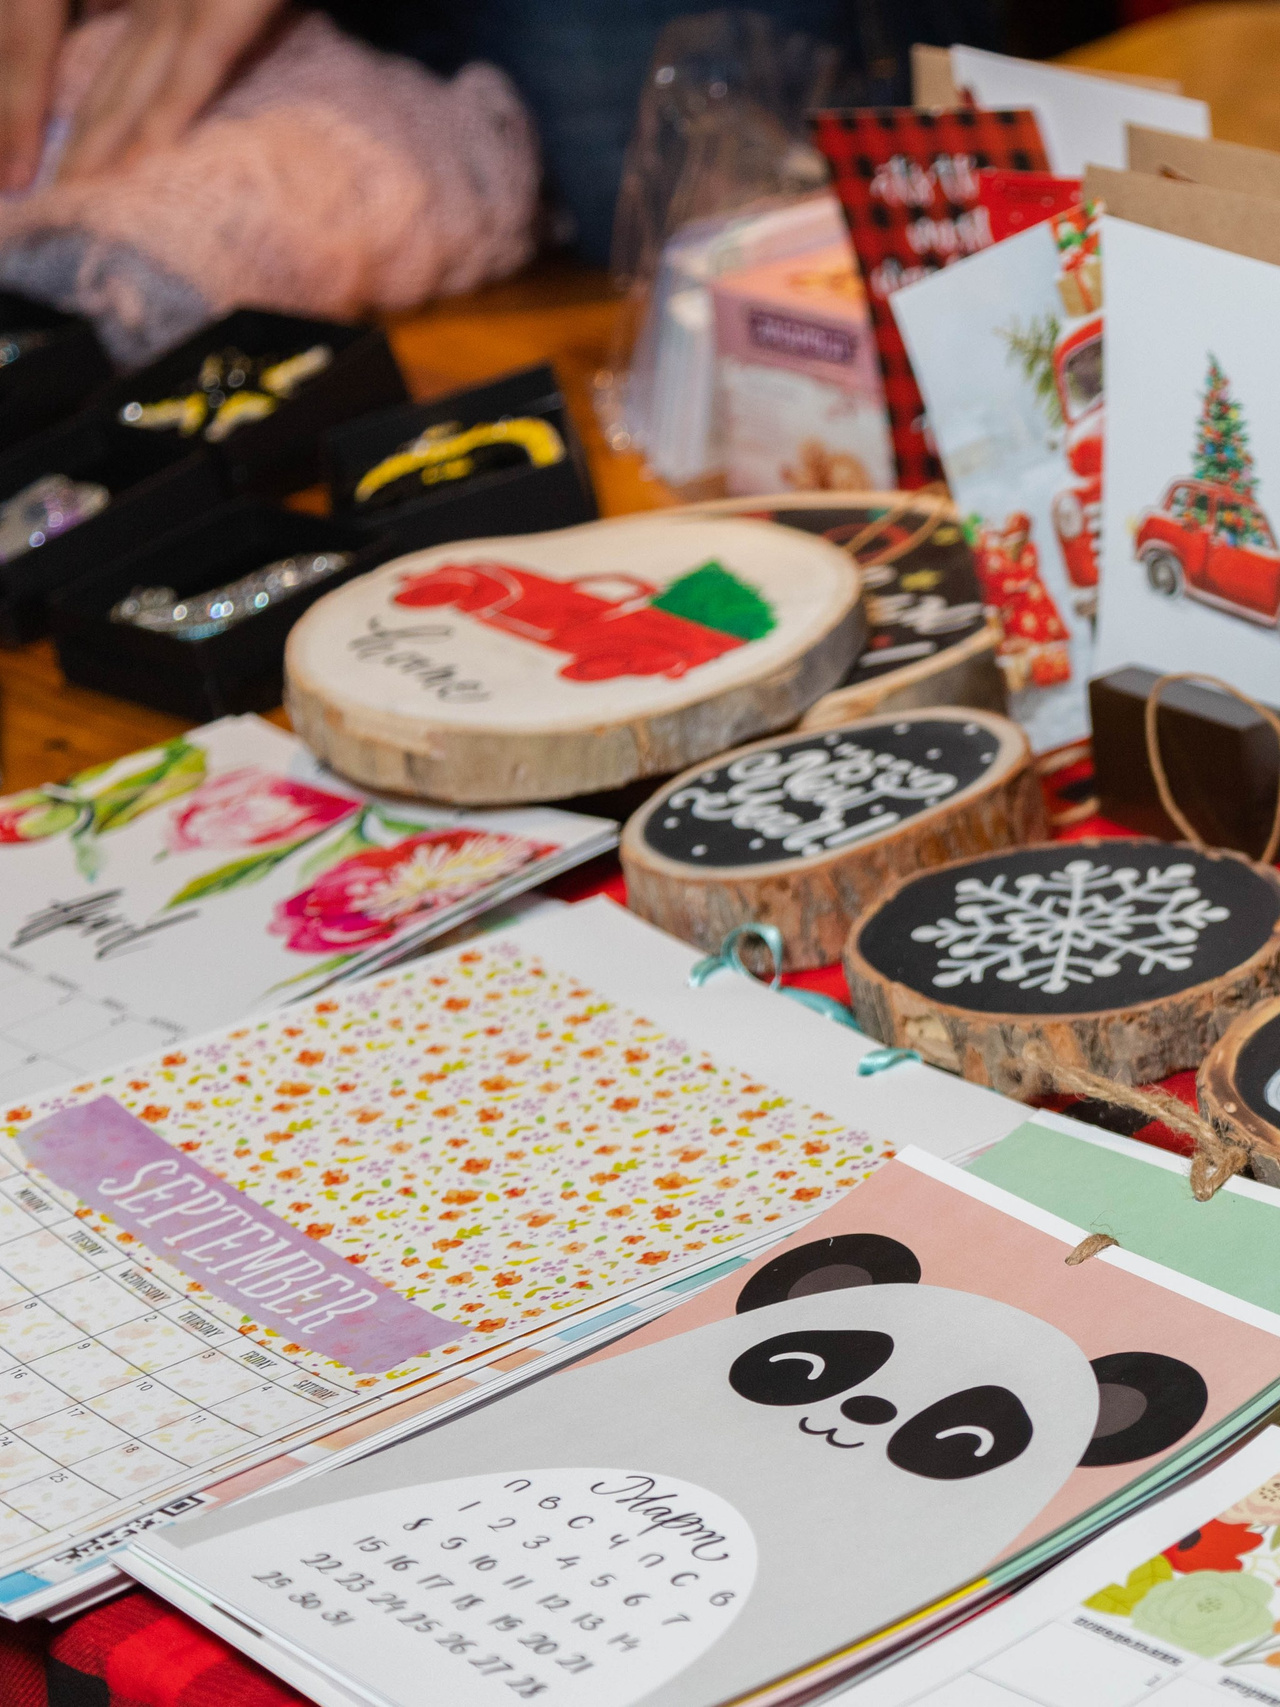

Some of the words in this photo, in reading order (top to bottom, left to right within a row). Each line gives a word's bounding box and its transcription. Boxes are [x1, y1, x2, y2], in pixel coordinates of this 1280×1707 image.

[98, 1159, 378, 1334] SEPTEMBER
[24, 1302, 38, 1310] 8
[77, 1342, 91, 1351] 9
[136, 1380, 153, 1392] 10
[190, 1414, 207, 1426] 11
[67, 1230, 108, 1257] TUESDAY
[118, 1268, 172, 1303] WEDNESDAY
[177, 1310, 224, 1339] THURSDAY
[239, 1350, 278, 1370] FRIDAY
[293, 1379, 340, 1401] SATURDAY
[144, 1315, 157, 1324] 2
[202, 1351, 216, 1360] 3
[261, 1383, 273, 1392] 4
[11, 1368, 28, 1380] 16
[66, 1408, 85, 1418] 17
[122, 1442, 140, 1455] 18
[49, 1471, 68, 1484] 25
[251, 1571, 293, 1589] 29
[288, 1592, 321, 1609] 30
[321, 1611, 355, 1626] 31
[300, 1553, 342, 1574] 22
[334, 1572, 375, 1593] 23
[366, 1592, 407, 1613] 24
[397, 1613, 443, 1633] 25
[434, 1633, 477, 1655] 26
[467, 1655, 514, 1676] 27
[503, 1676, 548, 1699] 28
[353, 1536, 389, 1552] 15
[384, 1555, 419, 1571] 16
[416, 1574, 455, 1590] 17
[451, 1594, 484, 1611] 18
[487, 1614, 523, 1631] 19
[517, 1633, 559, 1654] 20
[554, 1654, 594, 1674] 21
[403, 1517, 433, 1531] 8
[440, 1537, 467, 1550] 9
[469, 1555, 498, 1571] 10
[502, 1575, 534, 1590] 11
[536, 1594, 570, 1612] 12
[571, 1613, 605, 1631] 13
[607, 1633, 640, 1652] 14
[458, 1501, 481, 1511] 1
[487, 1517, 516, 1532] 2
[522, 1535, 550, 1550] 3
[556, 1556, 582, 1570] 4
[590, 1573, 617, 1588] 5
[623, 1593, 651, 1607] 6
[661, 1613, 691, 1627] 7
